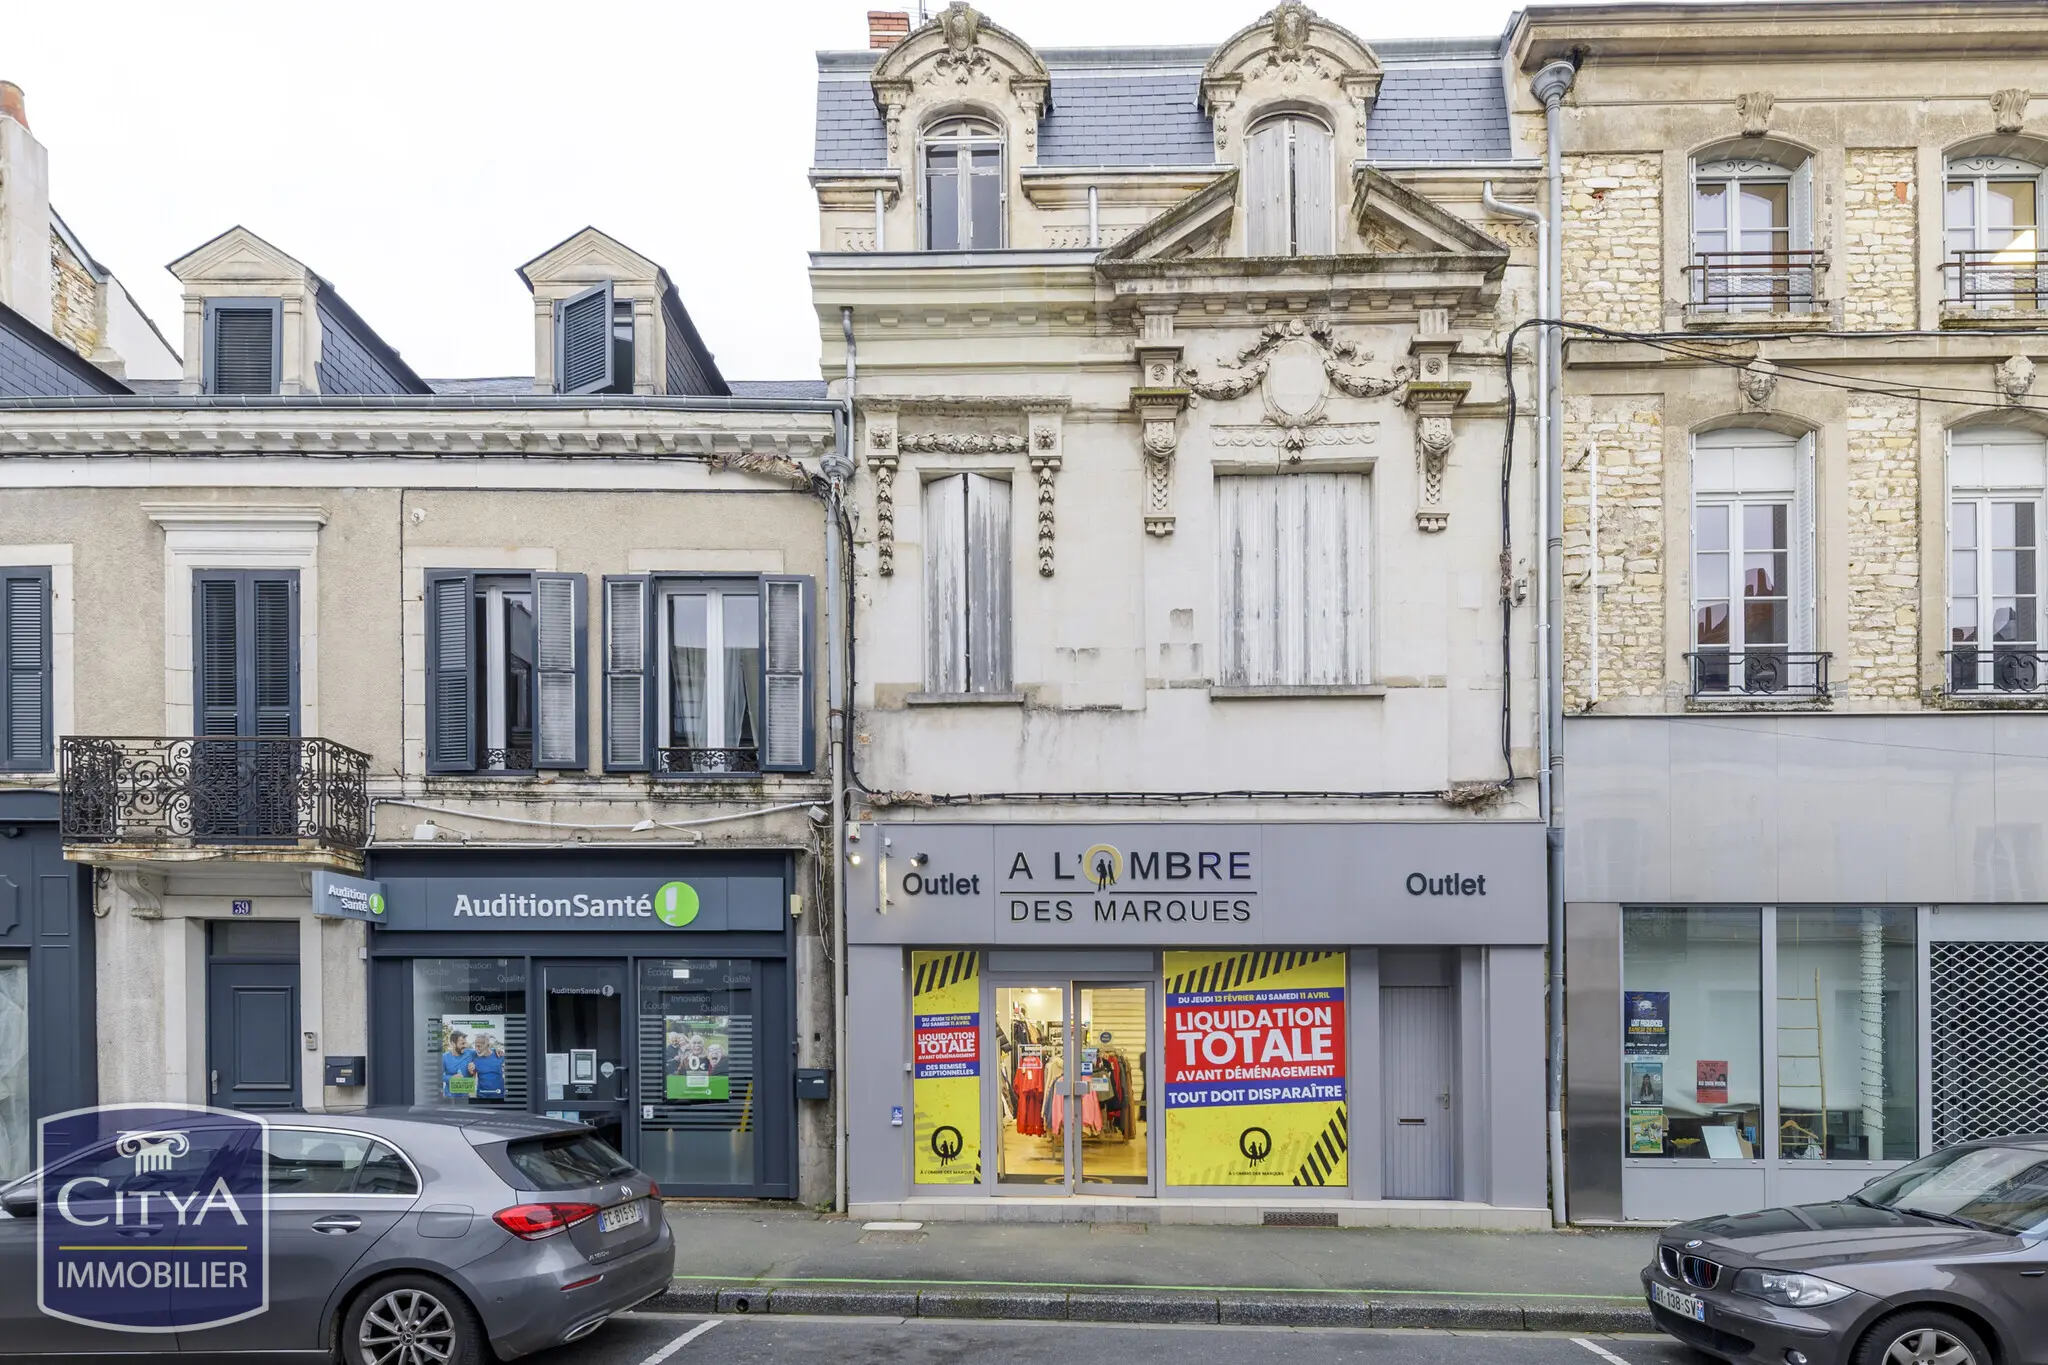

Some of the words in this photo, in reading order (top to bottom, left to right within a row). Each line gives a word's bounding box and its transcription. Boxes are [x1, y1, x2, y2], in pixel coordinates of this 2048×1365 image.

[1008, 851, 1034, 880] A
[1054, 844, 1252, 886] L'OMBRE
[902, 872, 980, 896] Outlet
[1406, 872, 1487, 896] Outlet
[328, 884, 368, 901] Audition
[234, 901, 249, 914] 39
[341, 898, 368, 912] Santé
[453, 893, 652, 917] AuditionSanté
[1010, 900, 1074, 923] DES
[1094, 900, 1252, 923] MARQUES
[497, 974, 525, 983] Qualité
[722, 974, 751, 983] Qualité
[551, 987, 600, 995] AuditionSanté
[1178, 996, 1190, 1004] DU
[1190, 995, 1214, 1003] JEUDI
[1214, 995, 1222, 1003] 12
[1223, 992, 1255, 1002] FÉVRIER
[1268, 992, 1299, 1001] SAMEDI
[1307, 991, 1331, 999] AVRIL
[445, 994, 485, 1003] Innovation
[671, 994, 711, 1003] Innovation
[475, 1003, 504, 1012] Qualité
[700, 1003, 729, 1013] Qualité
[1175, 1006, 1332, 1033] LIQUIDATION
[918, 1031, 975, 1042] LIQUIDATION
[918, 1039, 975, 1054] TOTALE
[1176, 1027, 1333, 1066] TOTALE
[920, 1069, 974, 1077] EXEPTIONNELLES
[1175, 1069, 1222, 1082] AVANT
[1225, 1065, 1335, 1080] DÉMÉNAGEMENT
[1168, 1091, 1208, 1104] TOUT
[1211, 1089, 1245, 1102] DOIT
[1248, 1083, 1342, 1101] DISPARAÎTRE
